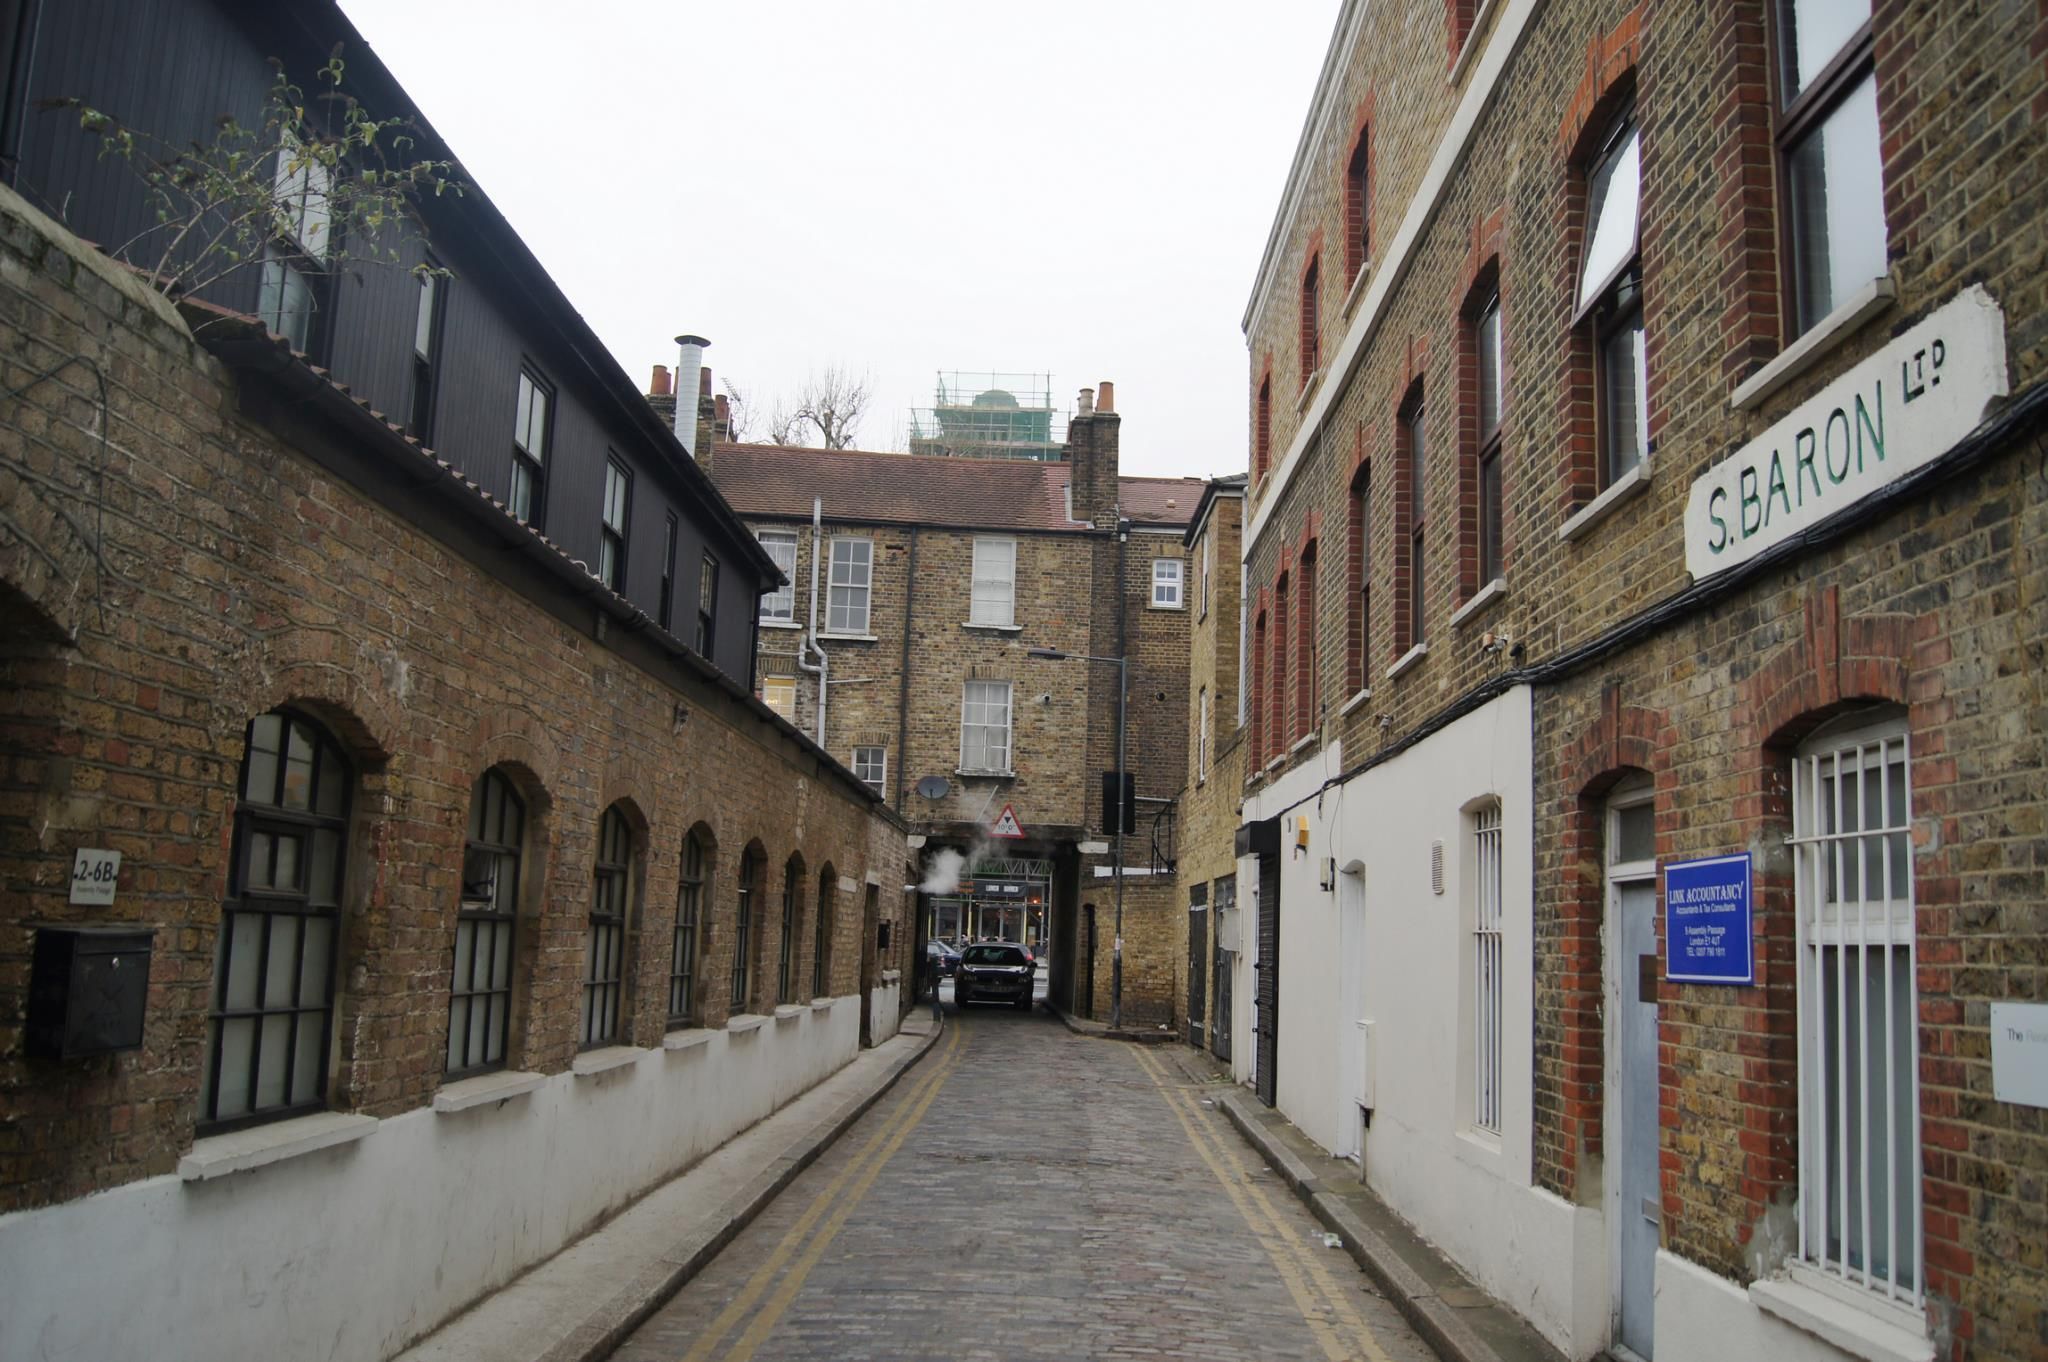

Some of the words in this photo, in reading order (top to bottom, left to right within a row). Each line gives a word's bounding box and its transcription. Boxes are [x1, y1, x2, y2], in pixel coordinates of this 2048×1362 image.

[79, 860, 113, 882] 2-6B
[1669, 889, 1685, 904] LINK
[1686, 881, 1744, 903] ACCOUNTANCY
[1711, 903, 1736, 912] Consultants
[1689, 937, 1704, 946] London
[2007, 1028, 2024, 1042] The
